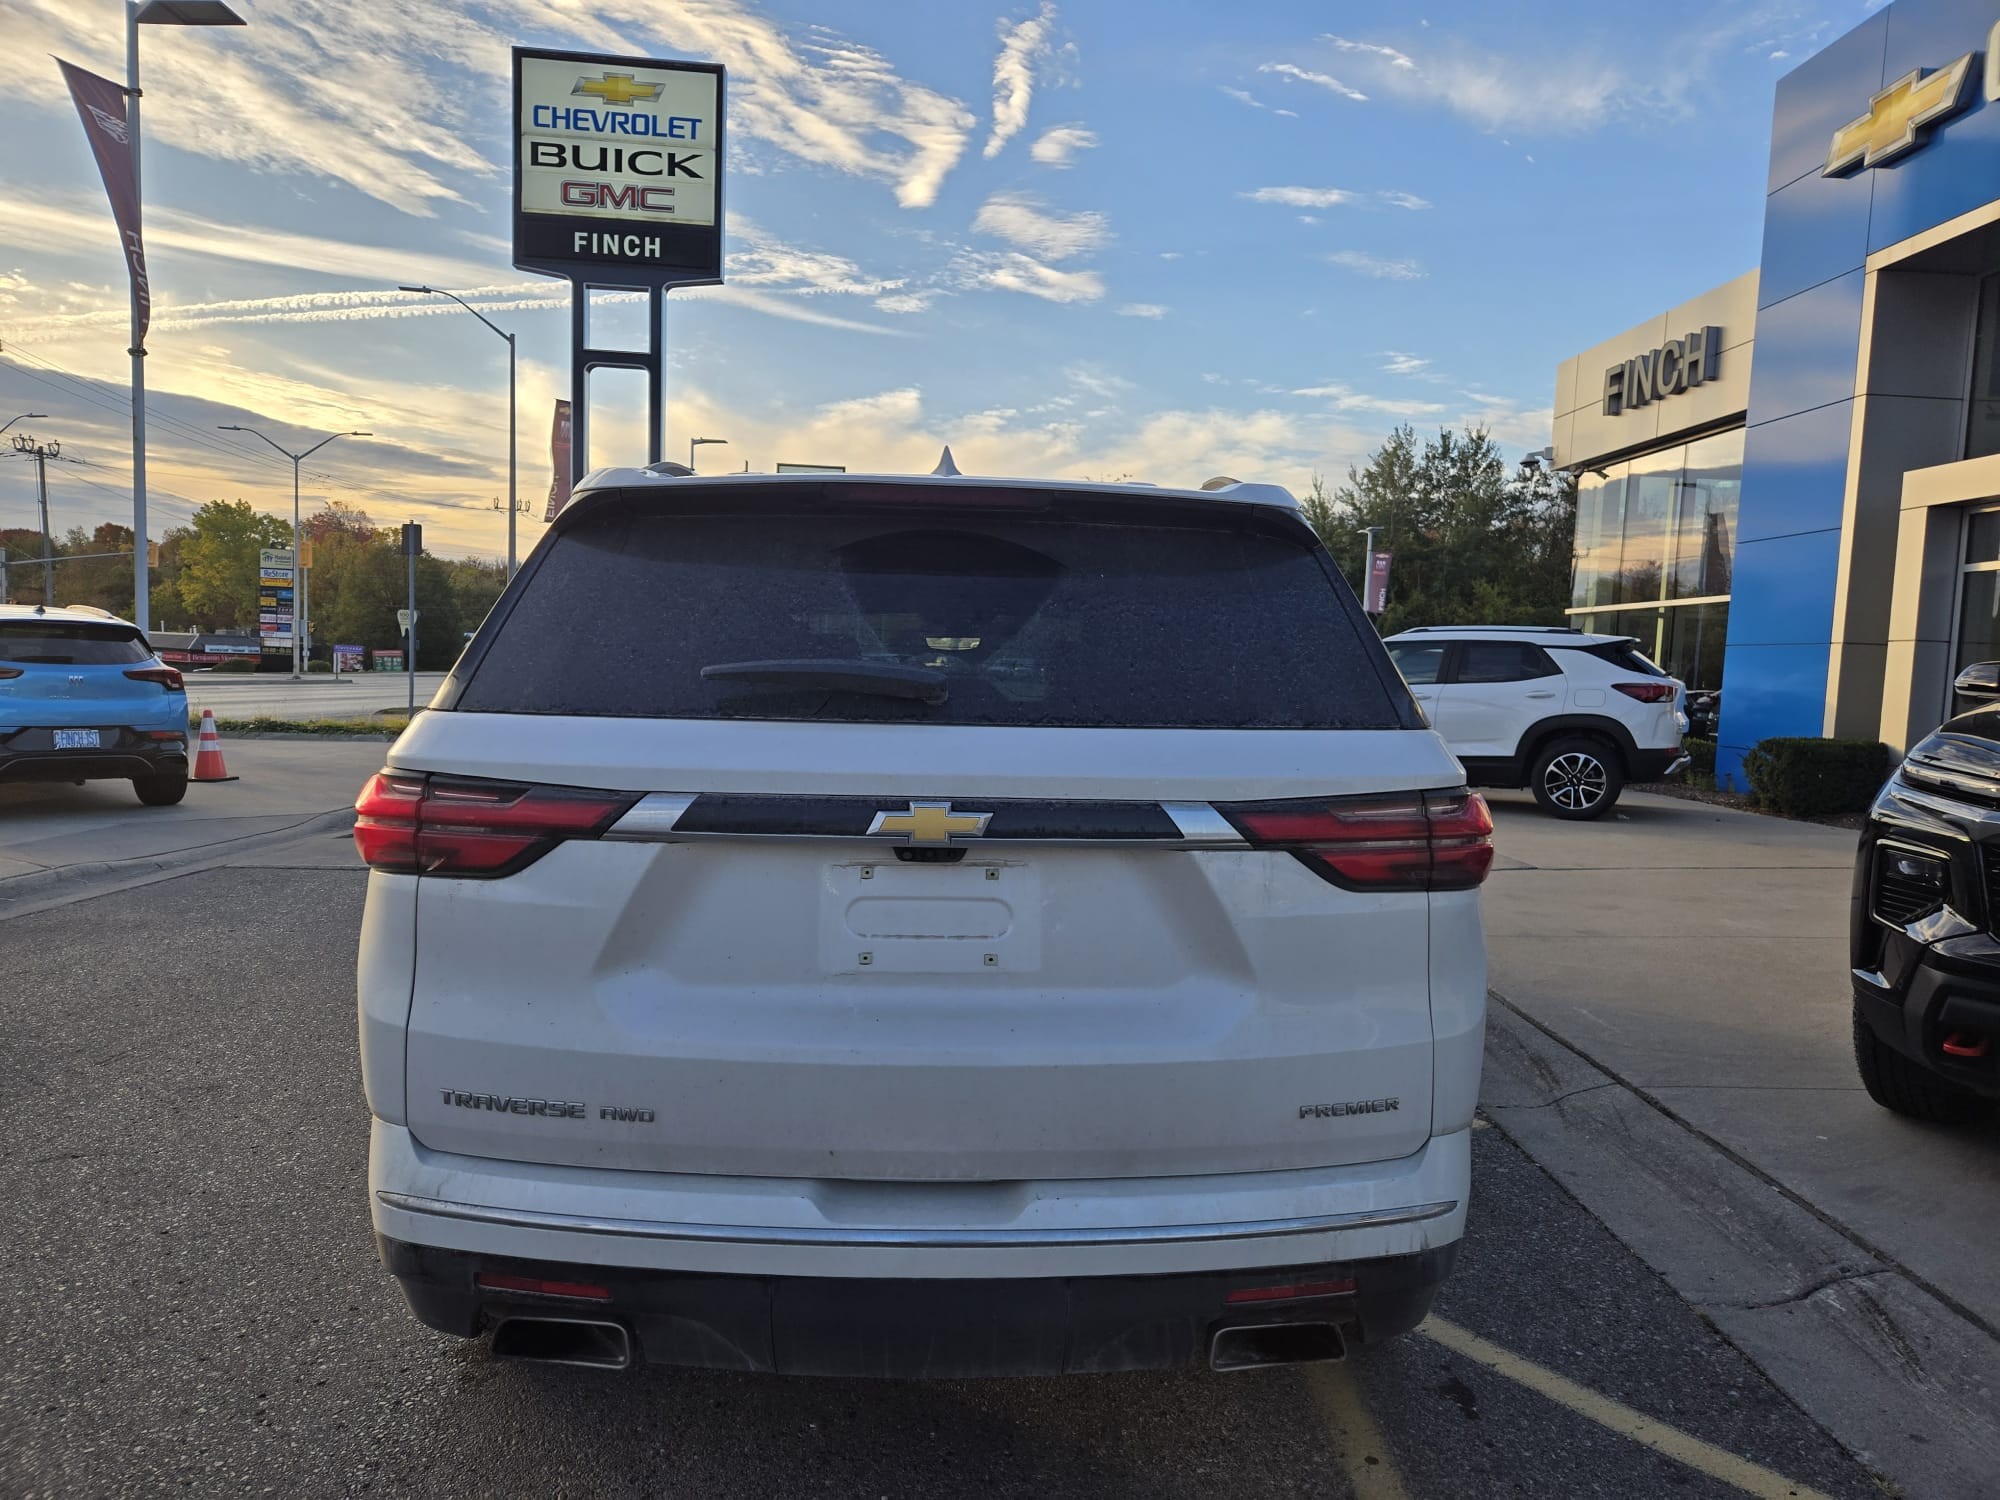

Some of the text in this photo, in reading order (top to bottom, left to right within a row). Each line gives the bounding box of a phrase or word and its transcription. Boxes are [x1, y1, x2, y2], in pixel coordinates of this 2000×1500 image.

[533, 104, 703, 140] CHEVROLET
[530, 141, 705, 180] BUICK
[560, 179, 676, 214] GMC
[574, 231, 661, 259] FINCH
[1603, 325, 1719, 416] FINCH
[439, 1088, 656, 1123] TRAVERSE AWD
[1299, 1097, 1400, 1120] PREMIER
